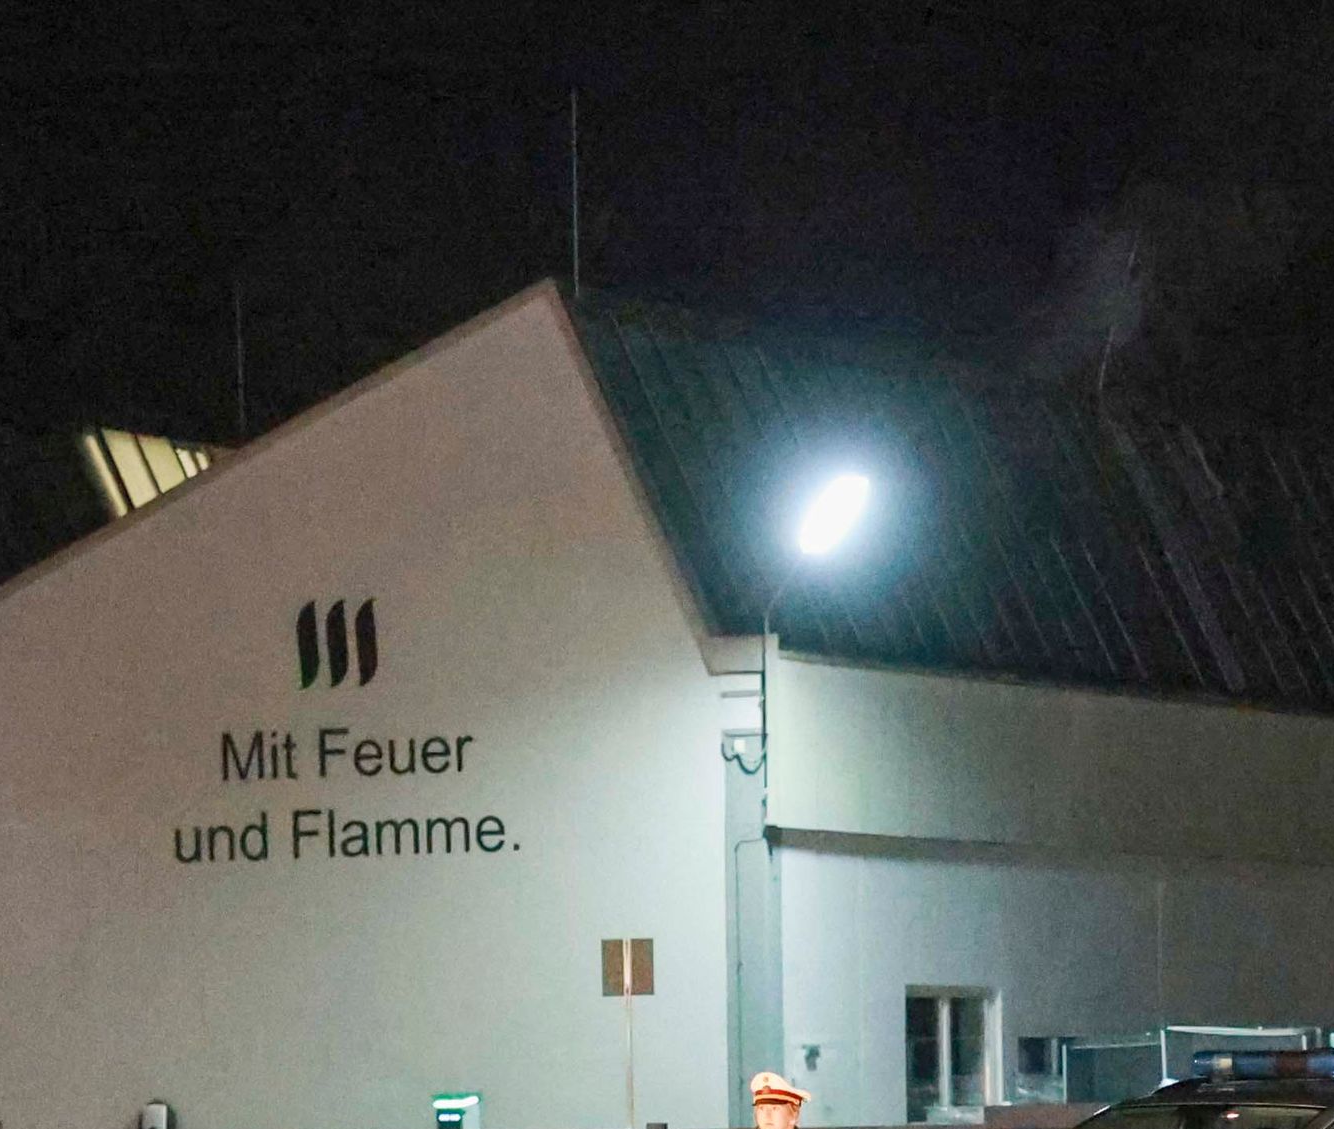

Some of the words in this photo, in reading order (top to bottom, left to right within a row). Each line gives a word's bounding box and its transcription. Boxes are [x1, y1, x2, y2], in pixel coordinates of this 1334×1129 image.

[220, 730, 298, 781] Mit
[318, 727, 474, 778] Feuer
[173, 811, 268, 864] und
[292, 808, 521, 859] Flamme.
